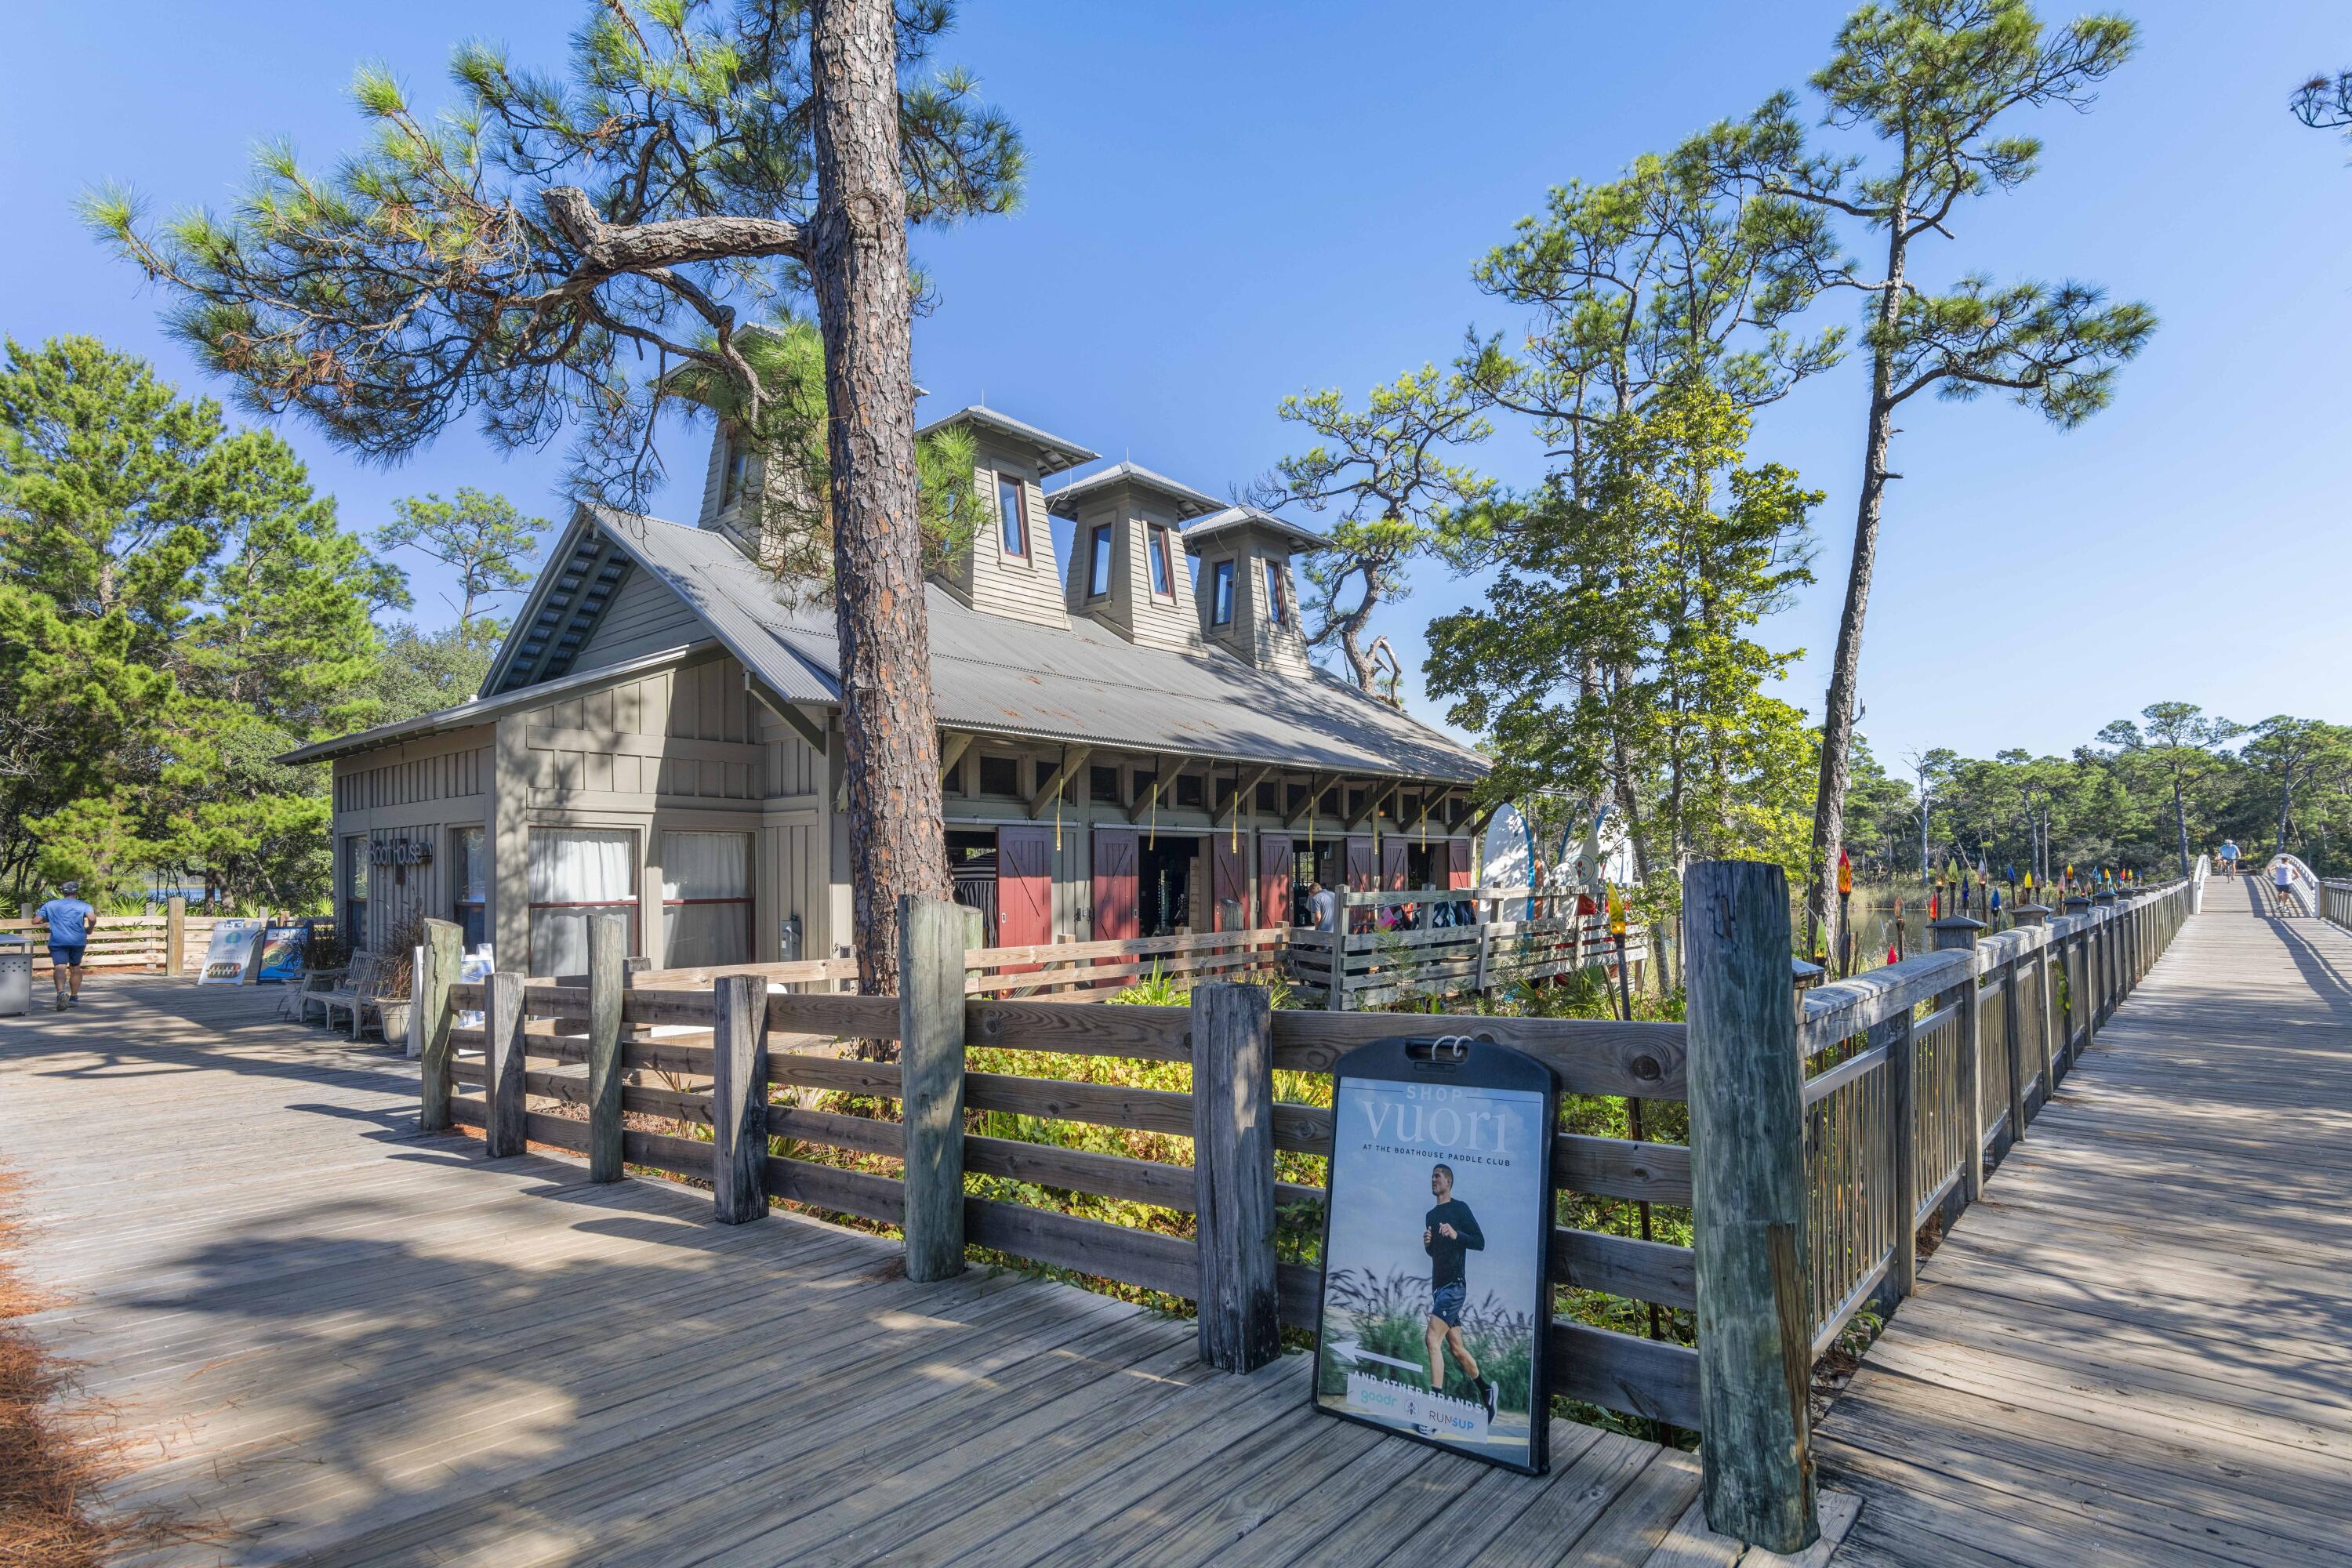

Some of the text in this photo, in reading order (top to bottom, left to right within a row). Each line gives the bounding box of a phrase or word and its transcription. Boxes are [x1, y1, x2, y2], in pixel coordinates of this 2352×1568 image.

[1406, 1085, 1463, 1103] SHOP
[1362, 1101, 1510, 1154] vuori
[1394, 1147, 1444, 1159] BOATHOUSE
[1448, 1153, 1483, 1164] PADDLE
[1486, 1158, 1511, 1167] CLUB
[1353, 1370, 1377, 1385] AND
[1382, 1378, 1423, 1397] OTHER
[1360, 1388, 1398, 1406] goodr
